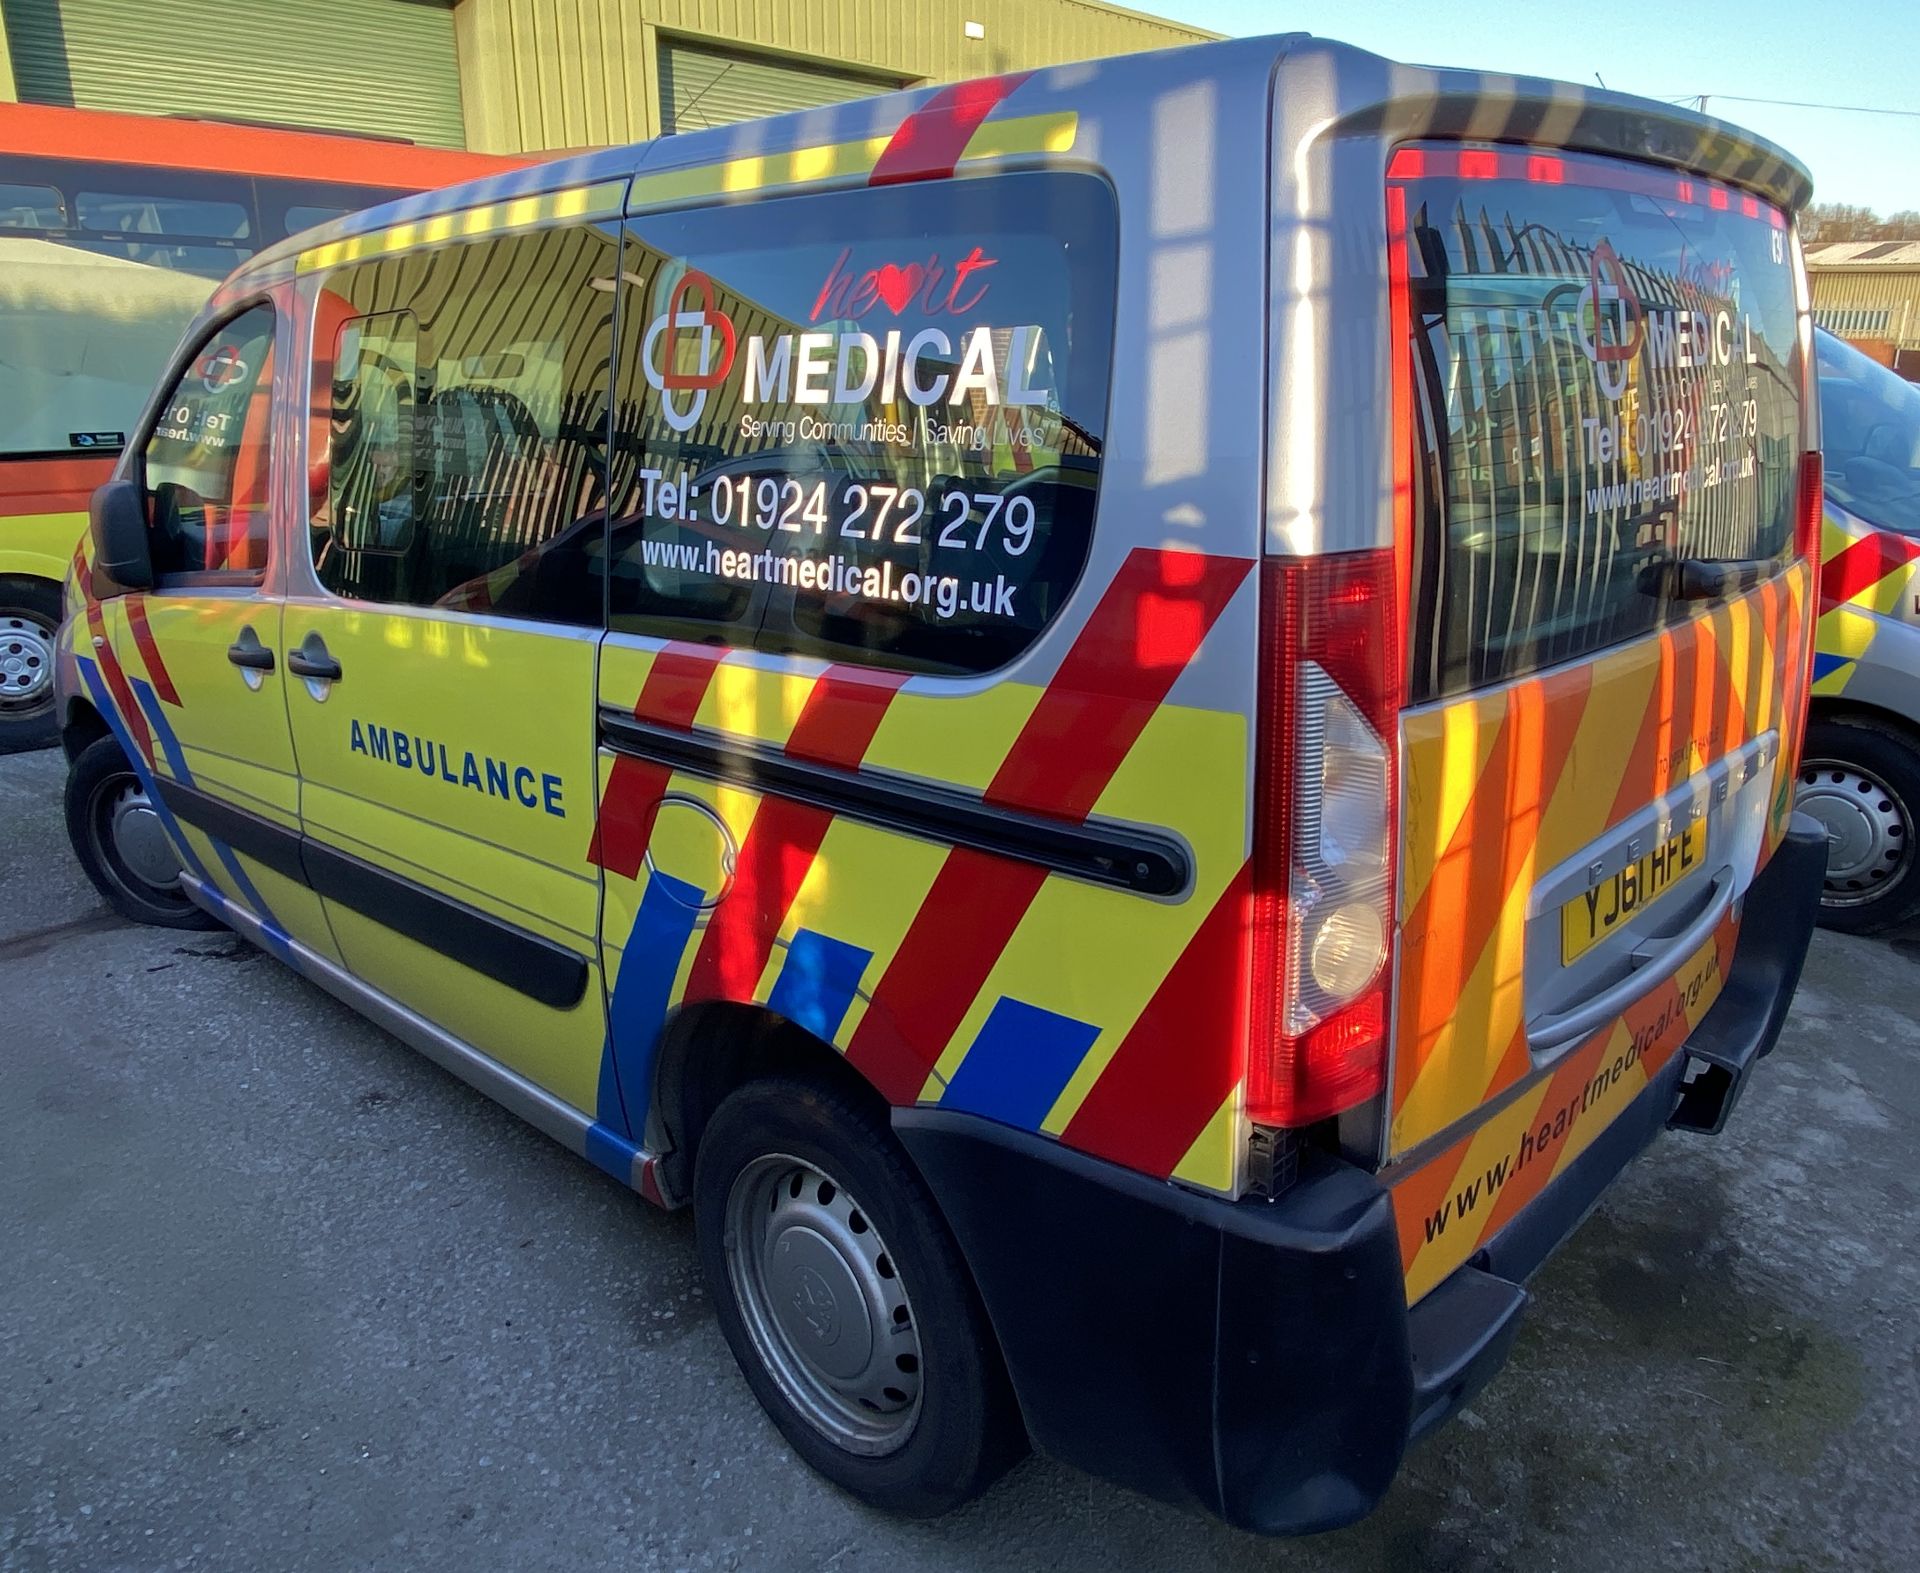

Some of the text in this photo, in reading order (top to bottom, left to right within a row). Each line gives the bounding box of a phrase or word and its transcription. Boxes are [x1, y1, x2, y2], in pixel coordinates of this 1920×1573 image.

[742, 325, 1049, 406] MEDICAL
[1647, 310, 1757, 369] MEDICAL
[740, 414, 796, 445] Serving
[799, 414, 907, 445] Communities
[926, 417, 986, 451] Saving
[640, 468, 1036, 557] Tel: 01924 272 279
[641, 538, 1018, 618] www.heartmedical.org.uk
[351, 719, 566, 819] AMBULANCE
[1424, 944, 1720, 1244] www.heartmedical.org.uk
